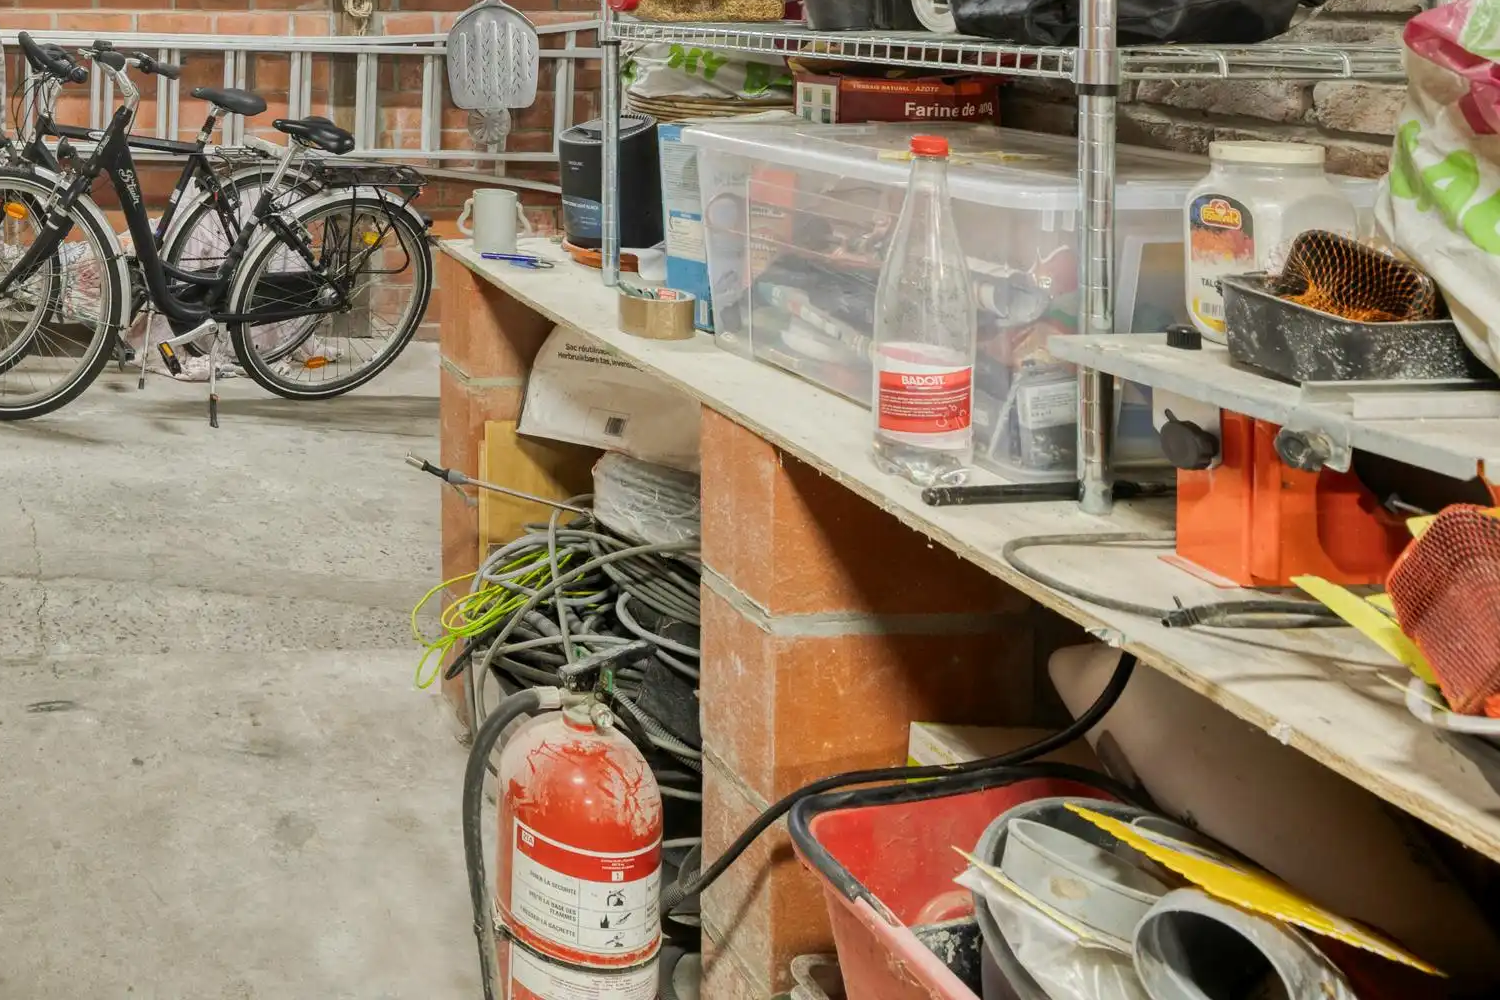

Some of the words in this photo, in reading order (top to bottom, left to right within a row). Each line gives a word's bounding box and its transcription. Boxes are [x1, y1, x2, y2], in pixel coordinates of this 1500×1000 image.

[904, 101, 959, 118] Farine
[962, 102, 976, 117] de
[564, 343, 577, 352] Sac
[901, 375, 946, 386] BADOIT
